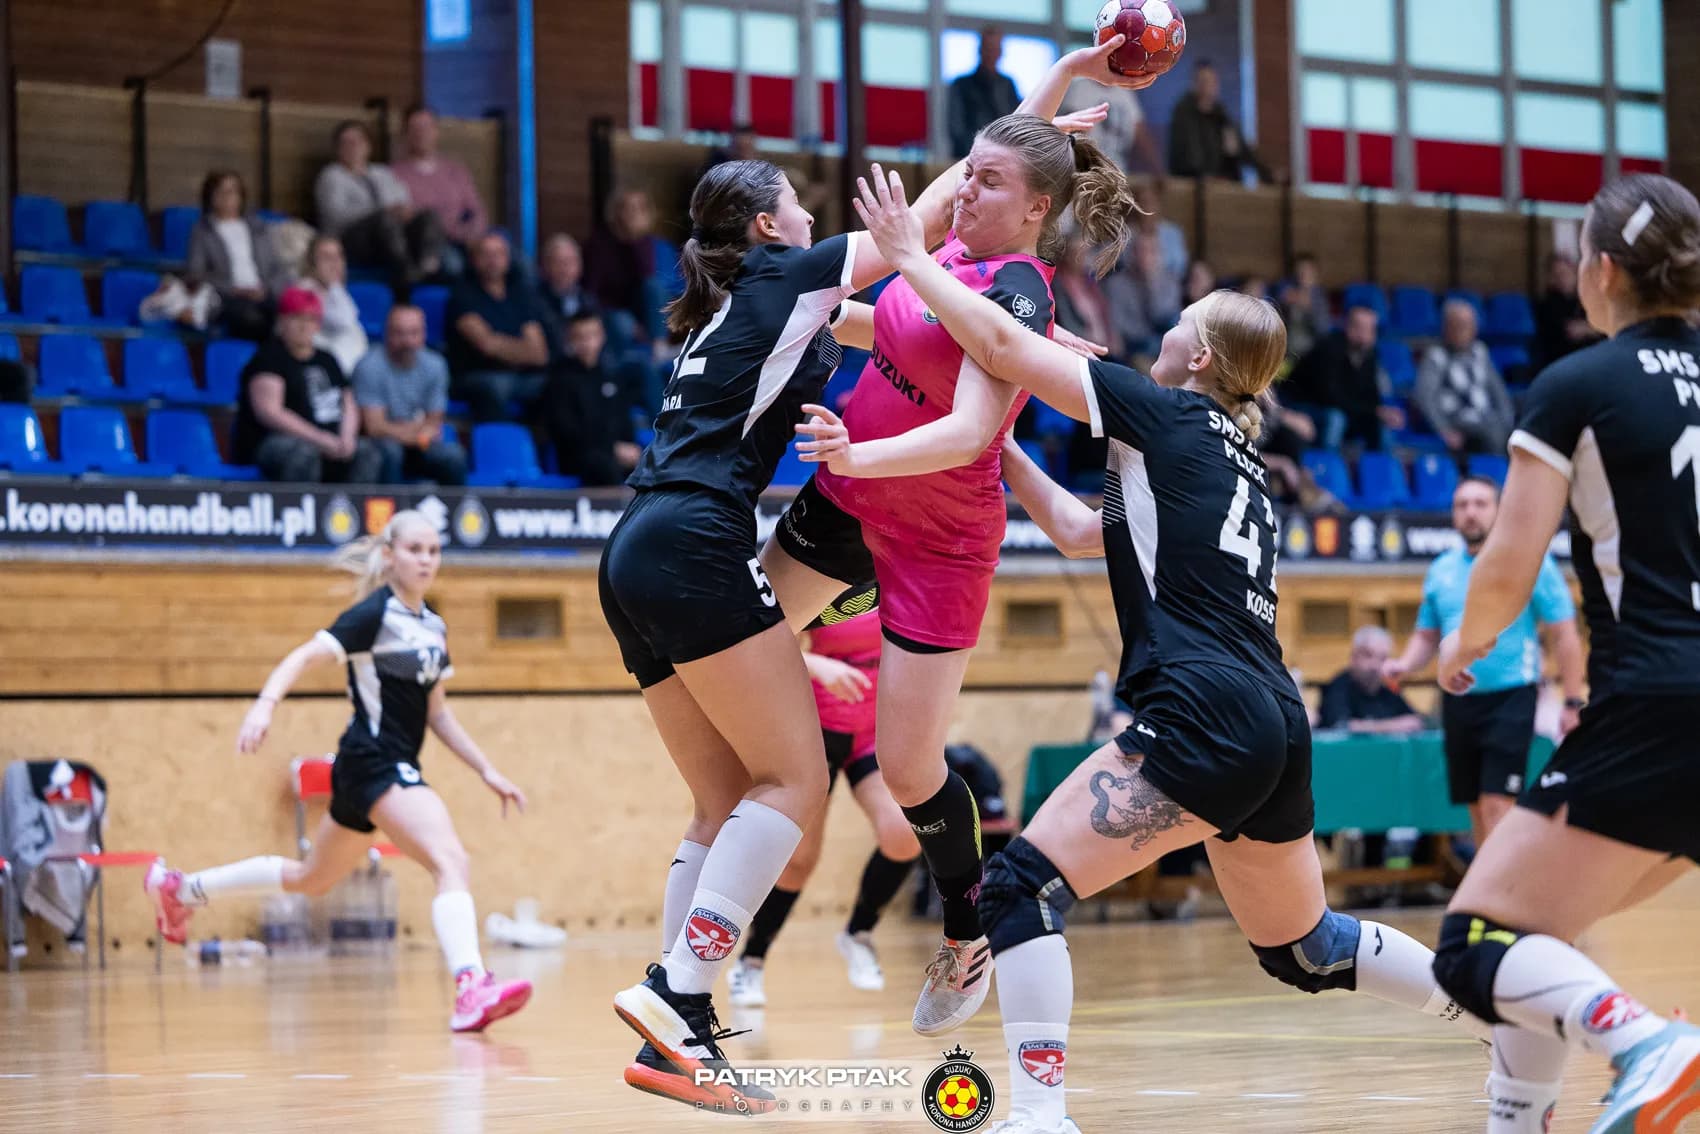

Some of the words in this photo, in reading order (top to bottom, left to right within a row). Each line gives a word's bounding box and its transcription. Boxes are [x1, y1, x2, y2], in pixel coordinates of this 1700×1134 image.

[871, 342, 926, 407] SUZUKI
[1638, 349, 1699, 378] SMS
[1208, 410, 1245, 445] SMS
[747, 557, 777, 607] 5
